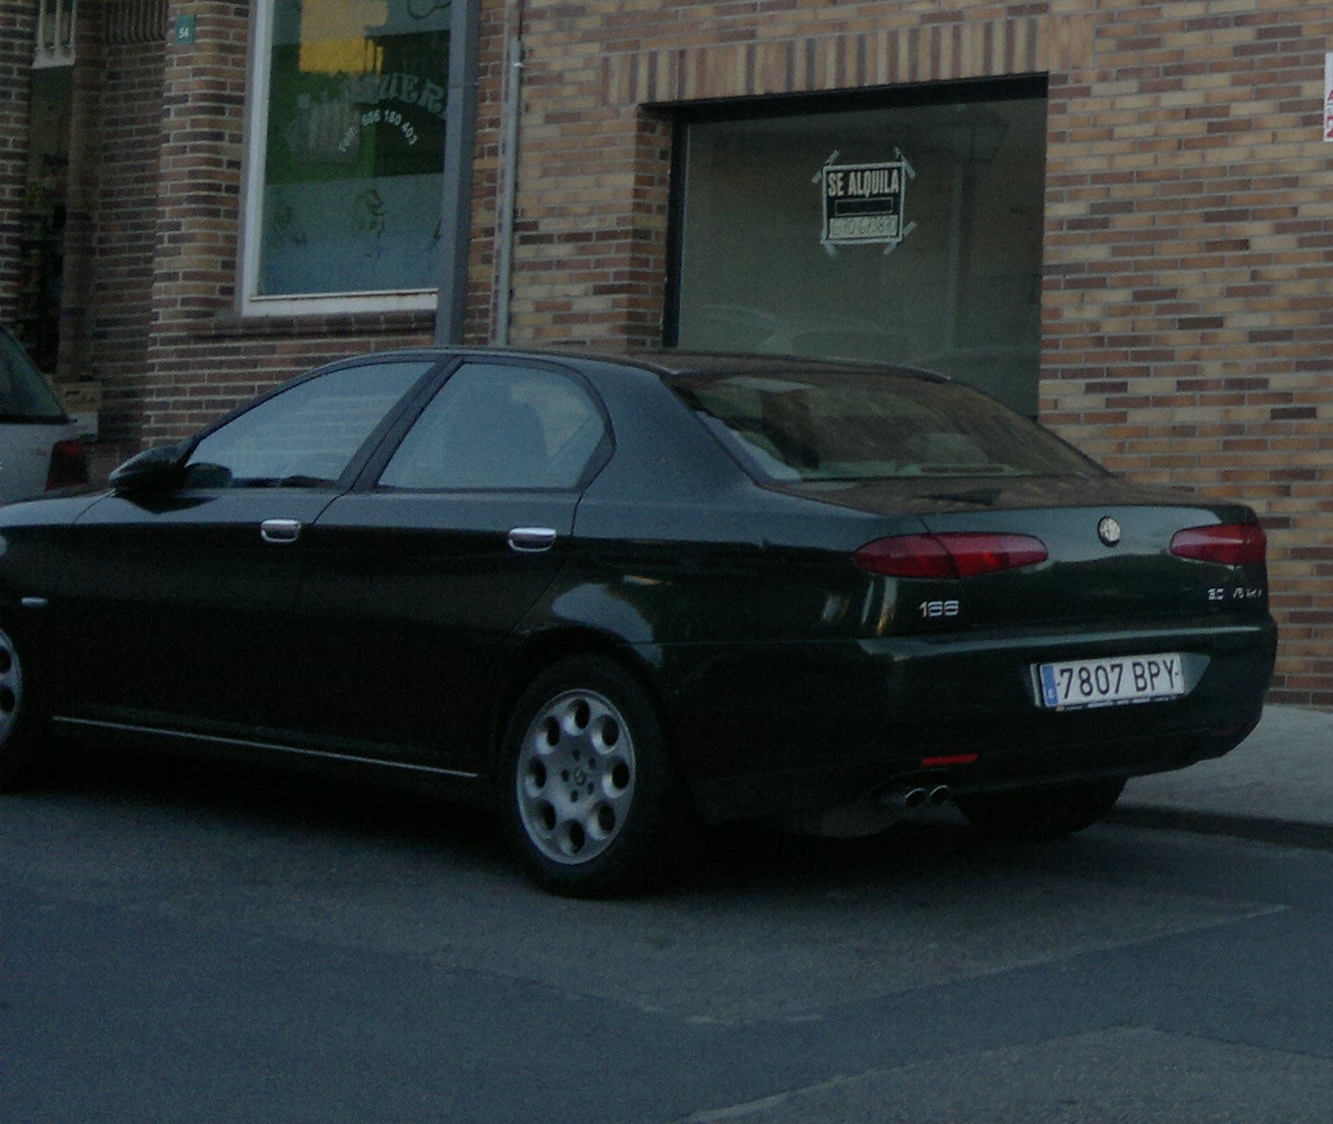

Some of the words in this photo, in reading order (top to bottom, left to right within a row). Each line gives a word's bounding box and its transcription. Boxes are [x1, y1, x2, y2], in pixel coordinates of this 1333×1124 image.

[827, 172, 844, 196] SE
[848, 169, 899, 197] ALQUILA
[1060, 663, 1123, 699] 7807
[1132, 659, 1175, 692] BPY
